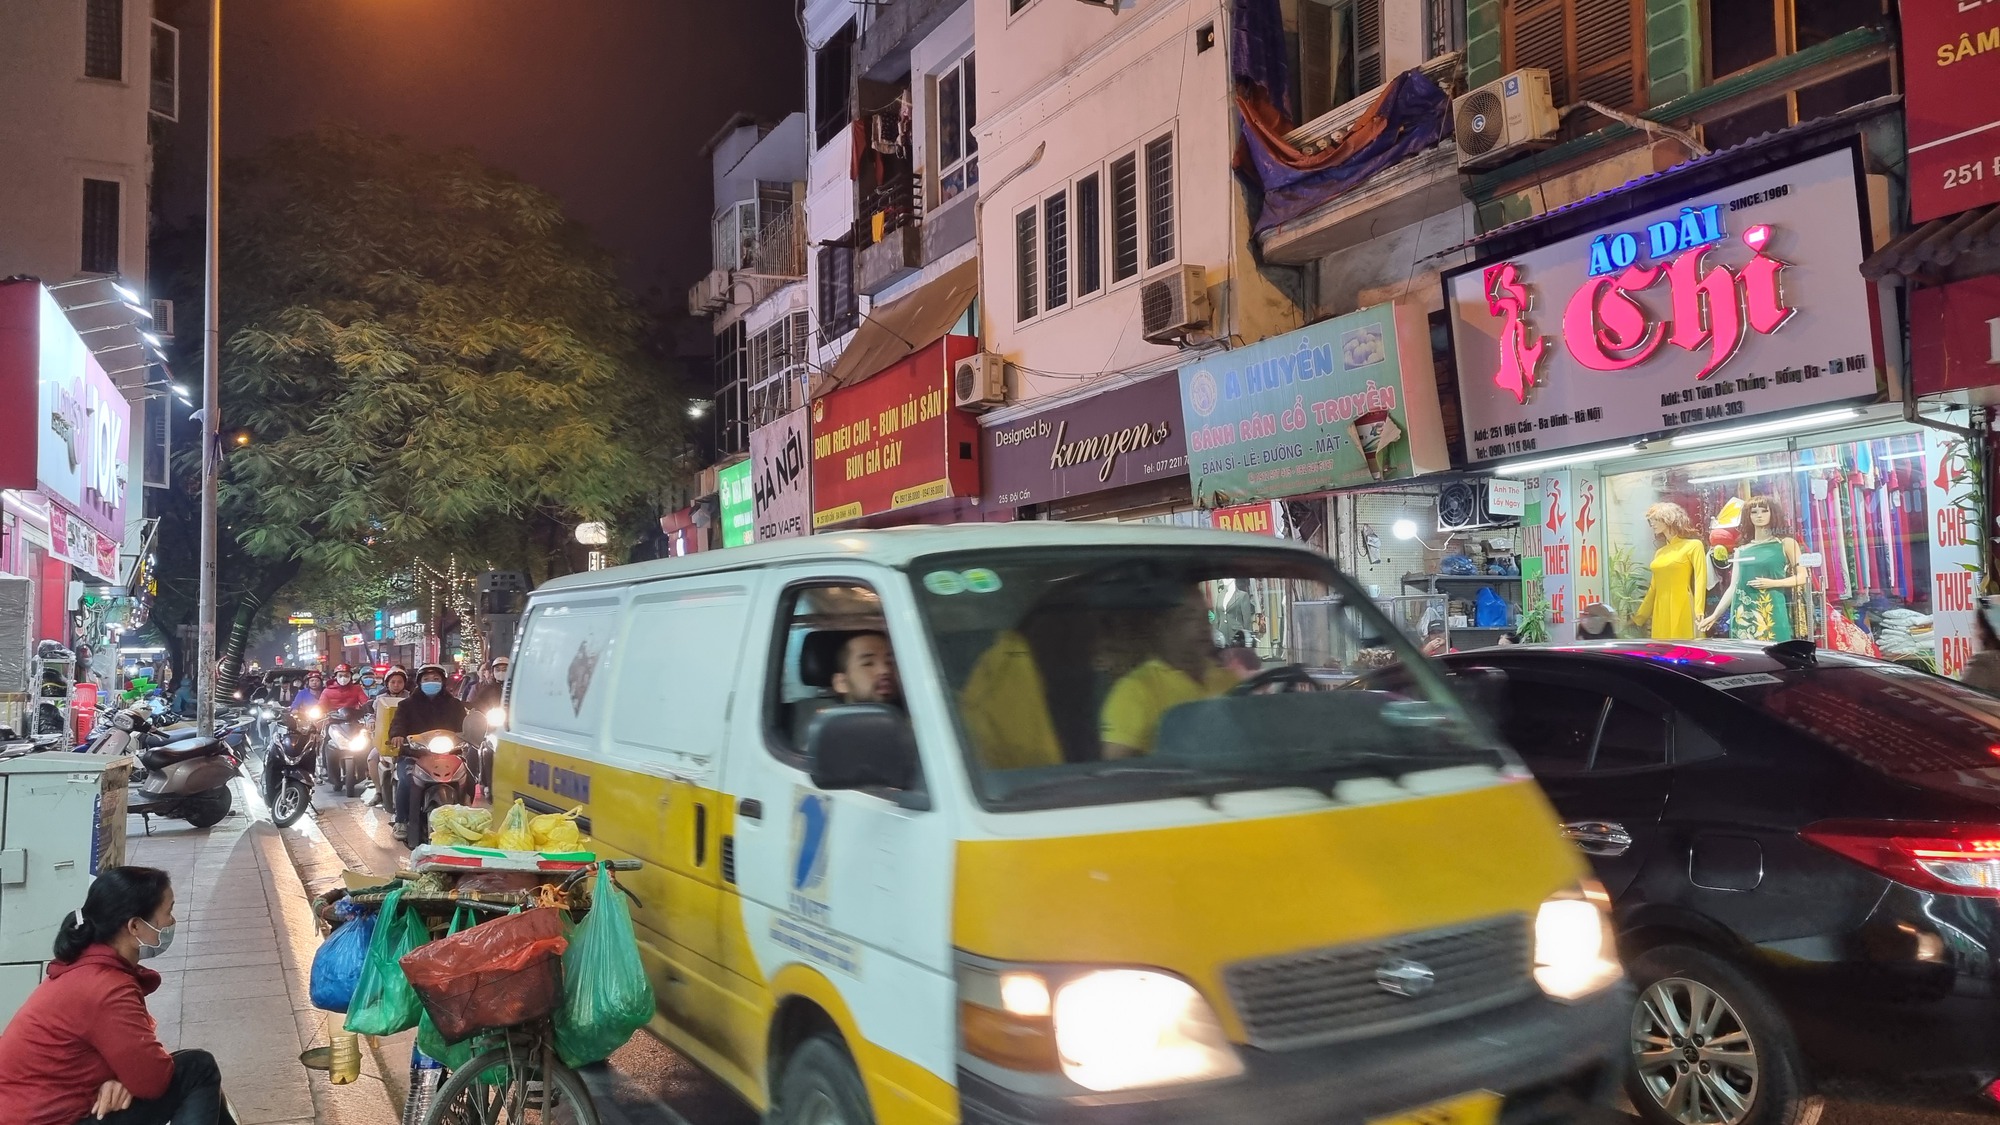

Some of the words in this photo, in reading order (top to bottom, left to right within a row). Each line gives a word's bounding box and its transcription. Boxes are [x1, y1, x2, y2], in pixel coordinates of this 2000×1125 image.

[1937, 27, 2000, 66] SÂM
[1943, 160, 1983, 190] 251
[1588, 234, 1639, 277] ÁO
[1647, 204, 1722, 259] DÀI
[1563, 223, 1798, 381] Chi
[1225, 371, 1241, 400] A
[1245, 336, 1334, 395] HUYỀN
[1660, 393, 1681, 407] Add:
[1682, 390, 1694, 402] 91
[1804, 364, 1819, 380] Đa
[1846, 353, 1867, 373] Nội
[814, 431, 831, 460] BÚN
[853, 418, 870, 447] CUA
[879, 405, 899, 437] BÚN
[901, 393, 917, 429] HẢI
[920, 385, 941, 422] SẢN
[995, 421, 1037, 447] Designed
[1039, 418, 1051, 438] by
[1191, 422, 1235, 452] BÁNH
[1239, 409, 1276, 442] RÁN
[1281, 395, 1307, 431] CỔ
[1311, 380, 1397, 426] TRUYỀN
[1490, 425, 1503, 439] 251
[1504, 423, 1517, 438] Đội
[1518, 419, 1533, 434] Cấn
[1538, 418, 1549, 430] Ba
[1574, 410, 1586, 423] Hà
[1587, 407, 1602, 422] Nội
[1662, 413, 1679, 427] Tel:
[1705, 404, 1723, 419] 444
[1725, 400, 1744, 416] 303
[846, 451, 863, 481] BÚN
[866, 441, 880, 475] GIẢ
[1143, 463, 1155, 475] Tel:
[1156, 460, 1168, 471] 077
[1169, 456, 1183, 469] 2211
[1202, 460, 1223, 475] BÁN
[1262, 442, 1303, 464] ĐƯỜNG
[1315, 433, 1341, 456] MẬT
[1507, 440, 1520, 453] 119
[754, 456, 777, 519] HÀ
[775, 426, 804, 491] NỘI
[760, 523, 777, 541] POD
[779, 516, 801, 535] VAPE
[1219, 510, 1268, 532] BÁNH
[1937, 508, 1966, 548] CHO
[1544, 536, 1569, 576] THIẾT
[1580, 539, 1599, 577] ÁO
[1552, 585, 1565, 624] KẾ
